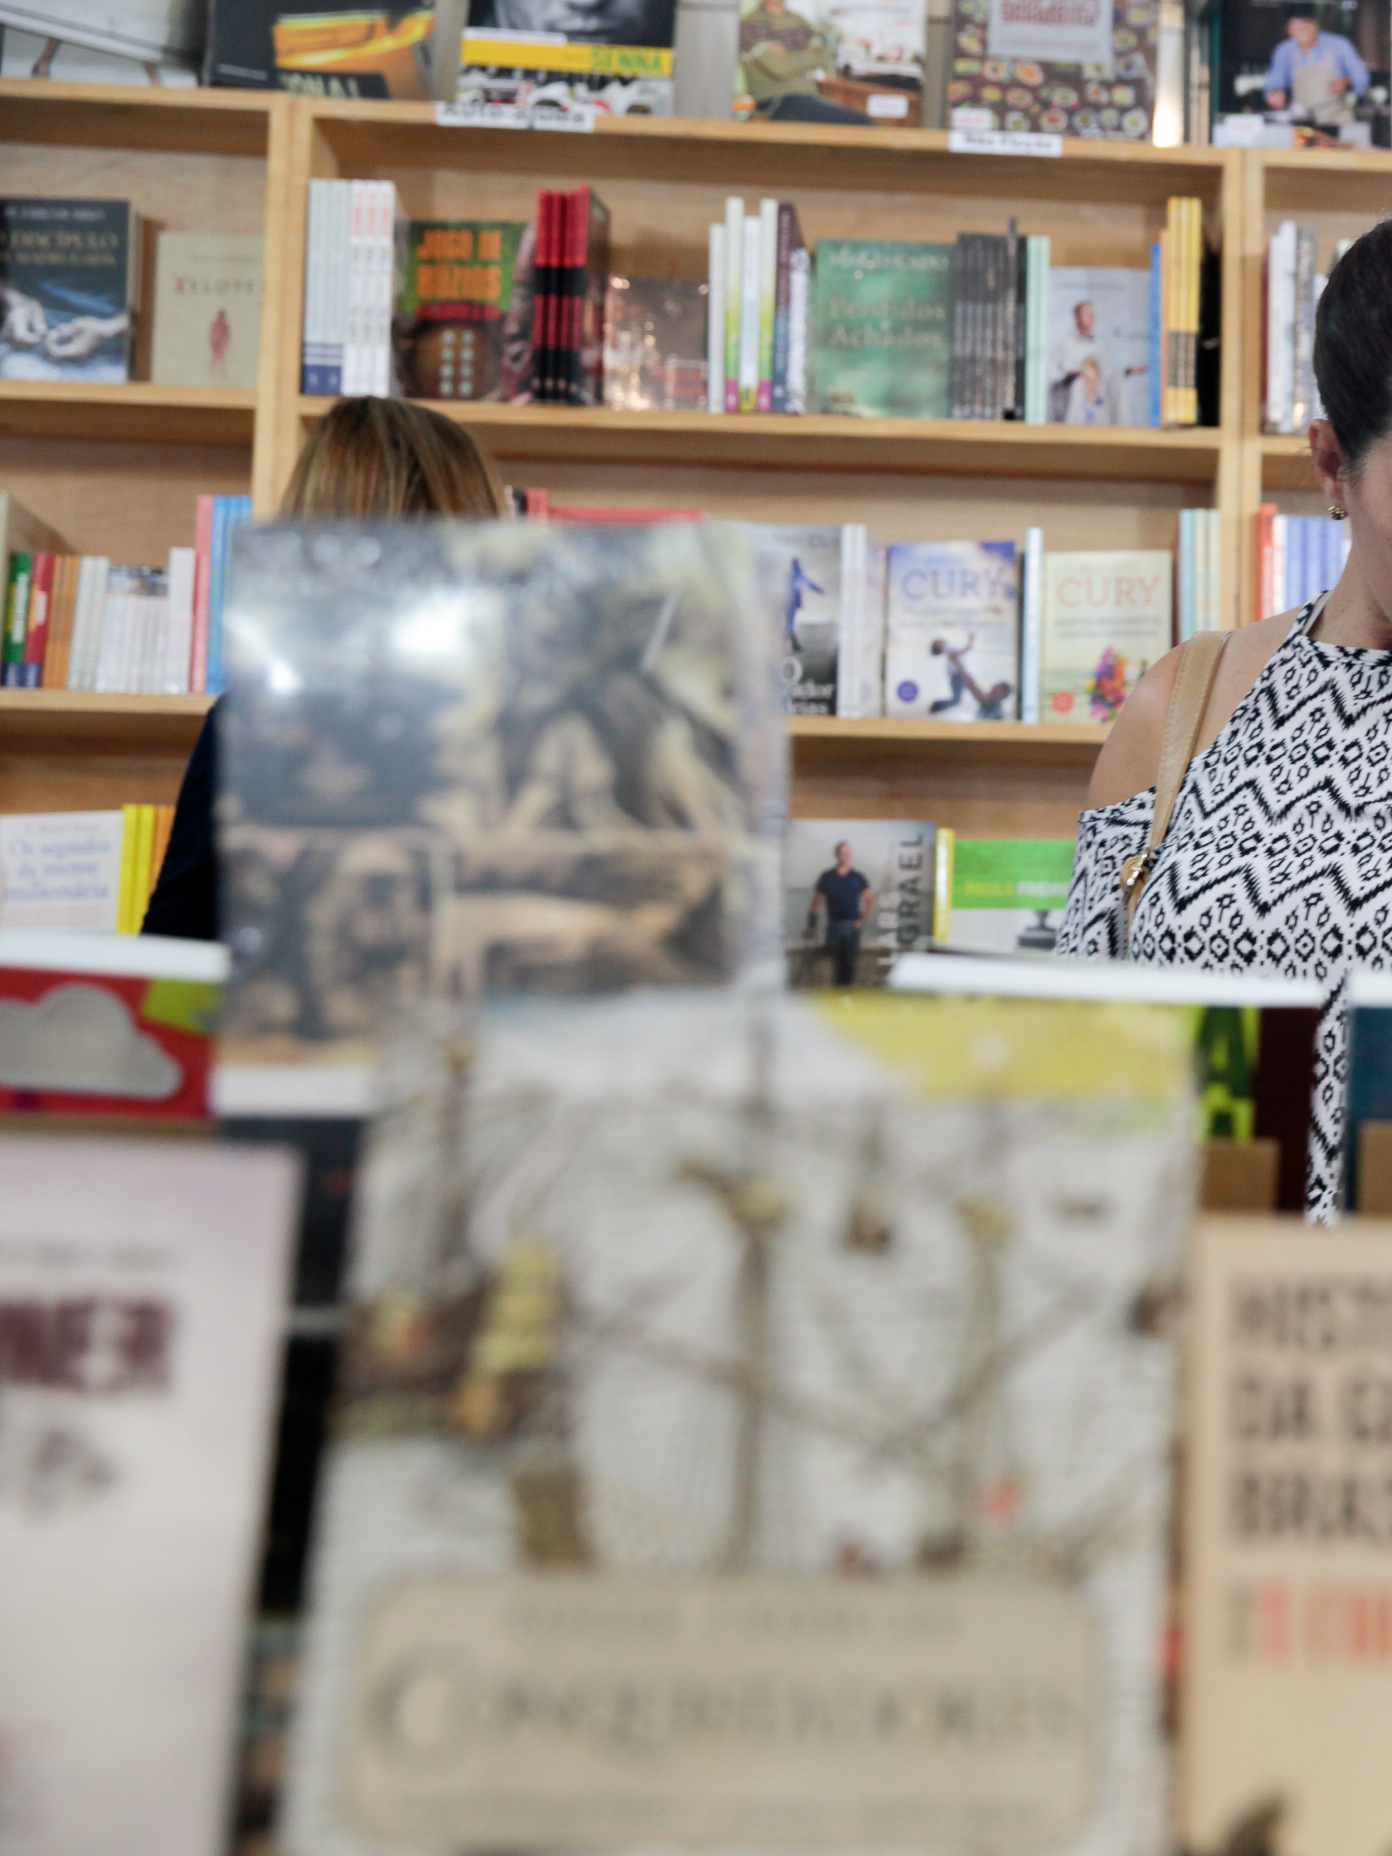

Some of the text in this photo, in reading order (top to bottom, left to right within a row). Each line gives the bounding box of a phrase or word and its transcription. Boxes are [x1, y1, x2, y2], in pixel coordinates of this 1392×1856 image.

[901, 568, 1008, 601] CURY
[1057, 574, 1162, 609] CURY
[897, 832, 925, 945] GRAEL
